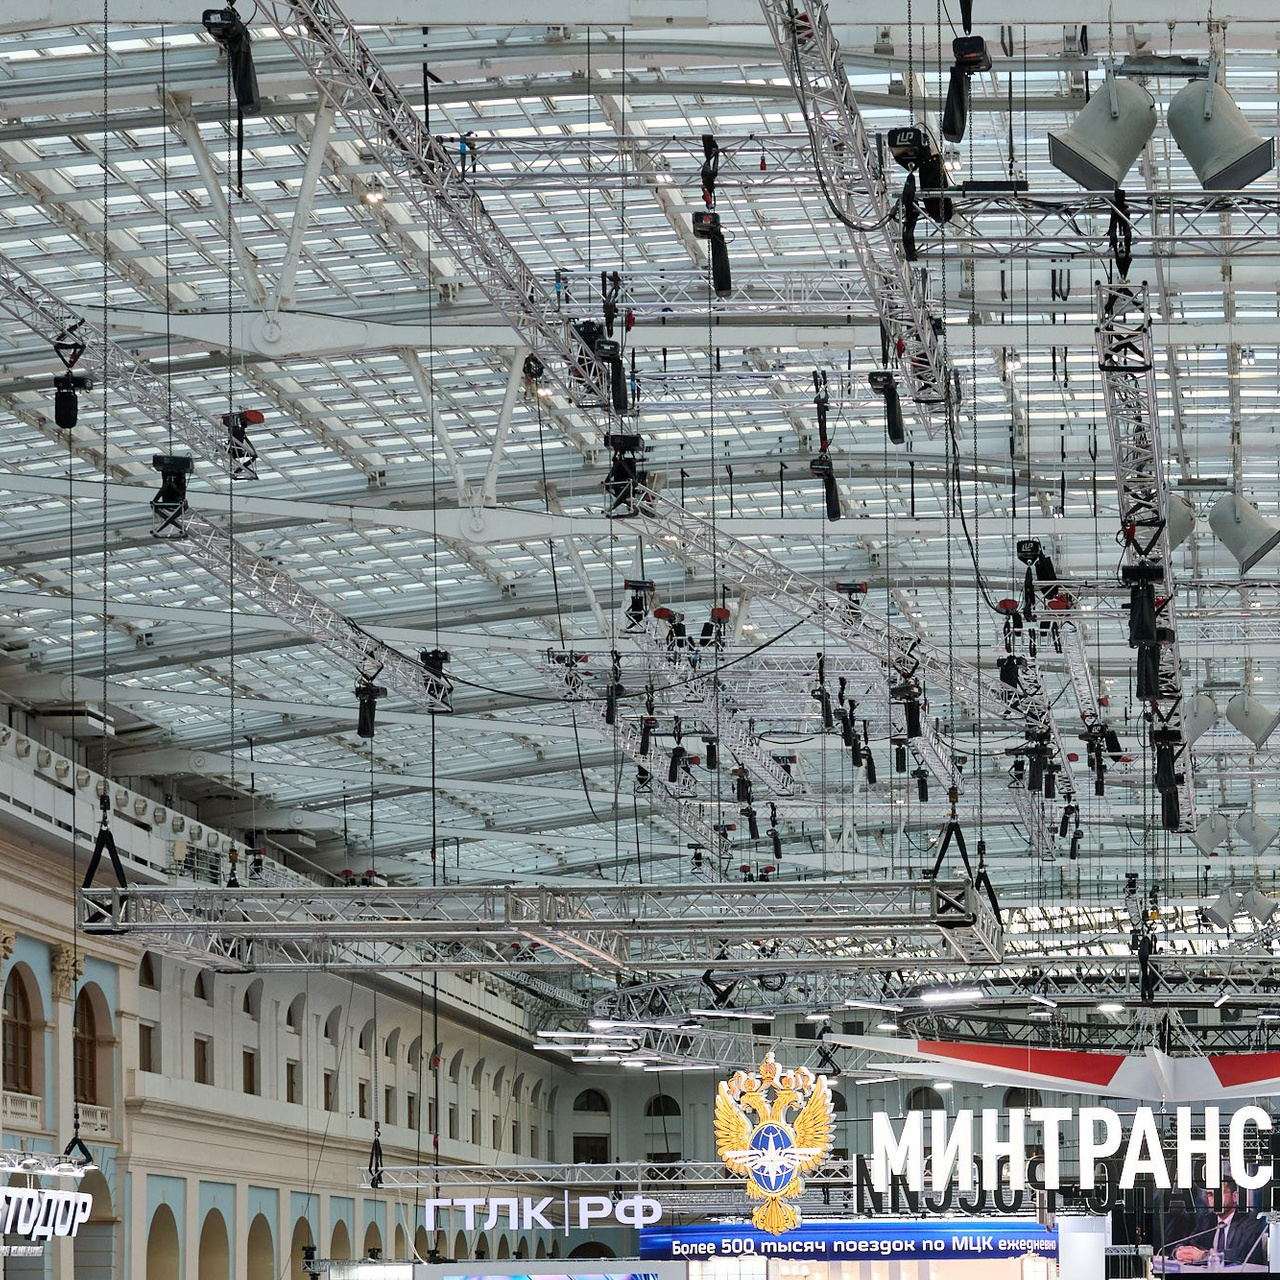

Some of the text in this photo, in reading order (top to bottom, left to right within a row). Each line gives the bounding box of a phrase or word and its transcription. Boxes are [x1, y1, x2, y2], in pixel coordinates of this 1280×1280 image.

[873, 1105, 1273, 1193] МИНТРАНС
[425, 1195, 663, 1232] ГТЛК РФ
[671, 1236, 1057, 1257] Более 500 тысяч поездок по МЦК ежедневно
